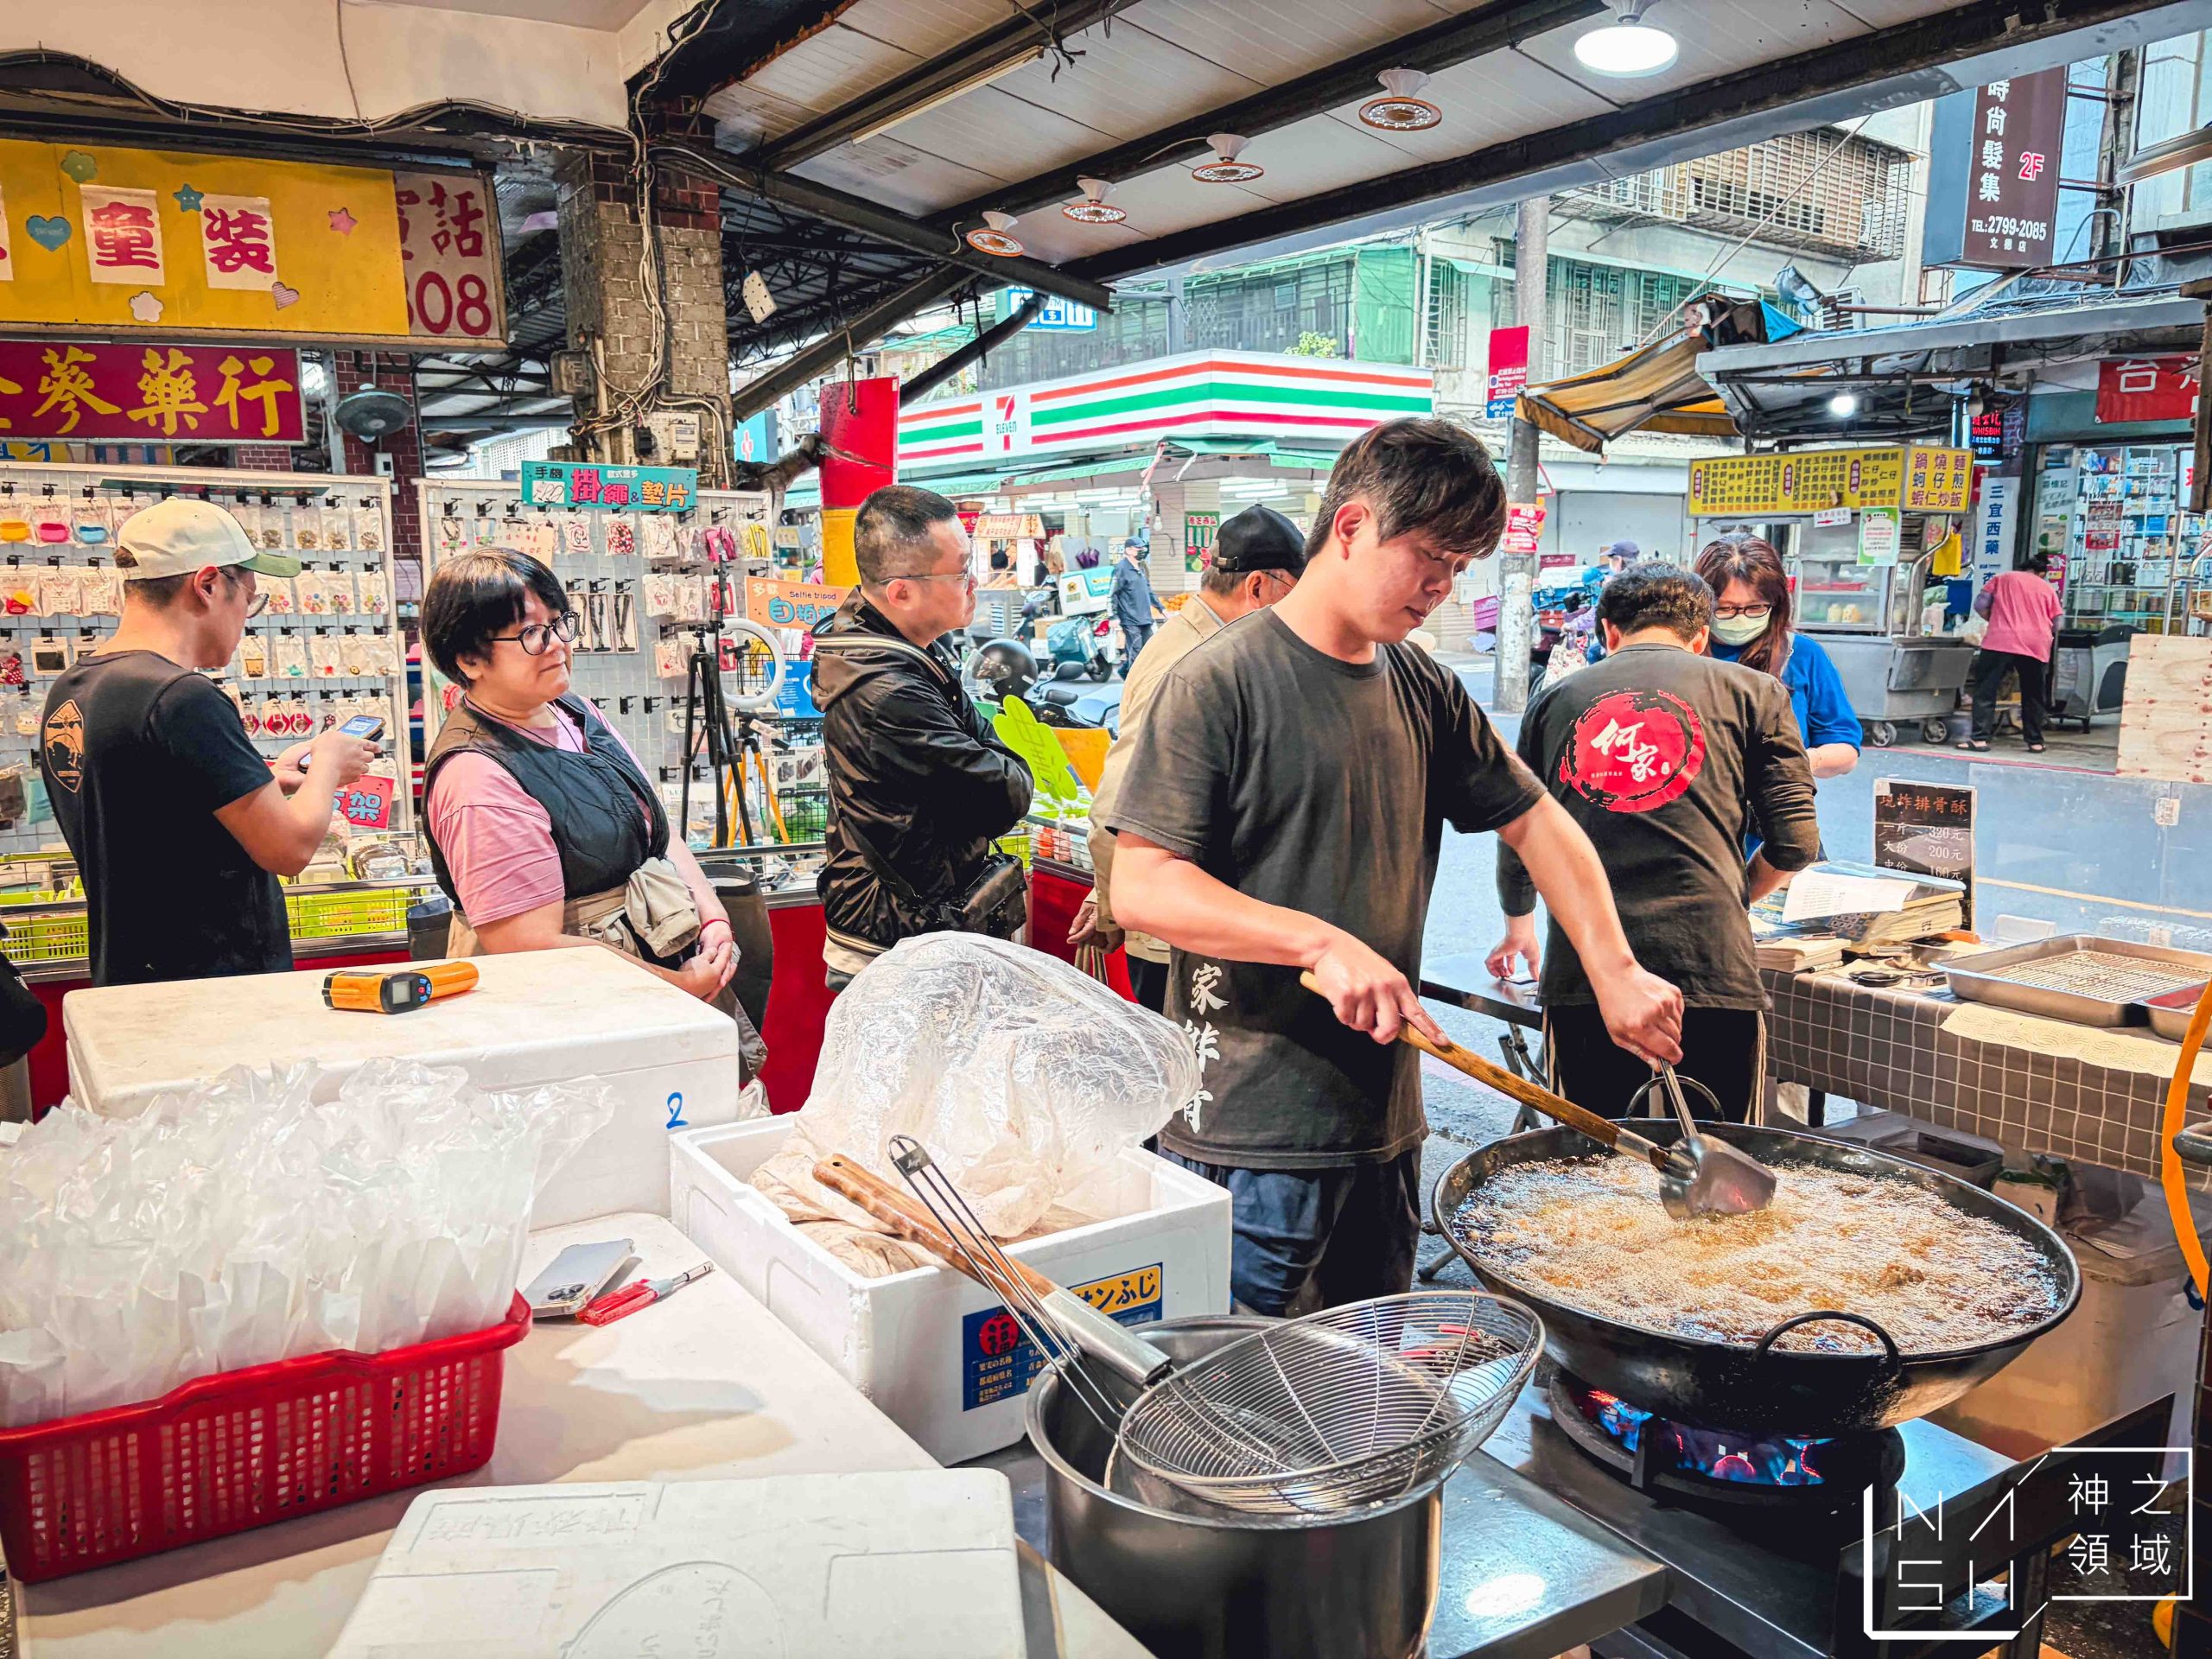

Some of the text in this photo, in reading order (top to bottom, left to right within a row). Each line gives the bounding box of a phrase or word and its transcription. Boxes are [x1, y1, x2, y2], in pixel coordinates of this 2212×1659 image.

[2018, 150, 2045, 181] 2F
[405, 270, 492, 336] 08
[0, 345, 294, 436] 蔘藥行
[535, 467, 563, 479] 手機
[1912, 471, 1965, 489] 蚵仔煎
[570, 467, 690, 507] 掛繩 & 墊片
[1910, 490, 1963, 508] 蝦仁炒飯
[789, 590, 836, 601] Selfie tripod
[1590, 717, 1659, 783] 何家
[1929, 826, 1964, 842] 320元
[1883, 840, 1964, 861] 大份 200元
[666, 1091, 689, 1129] 2
